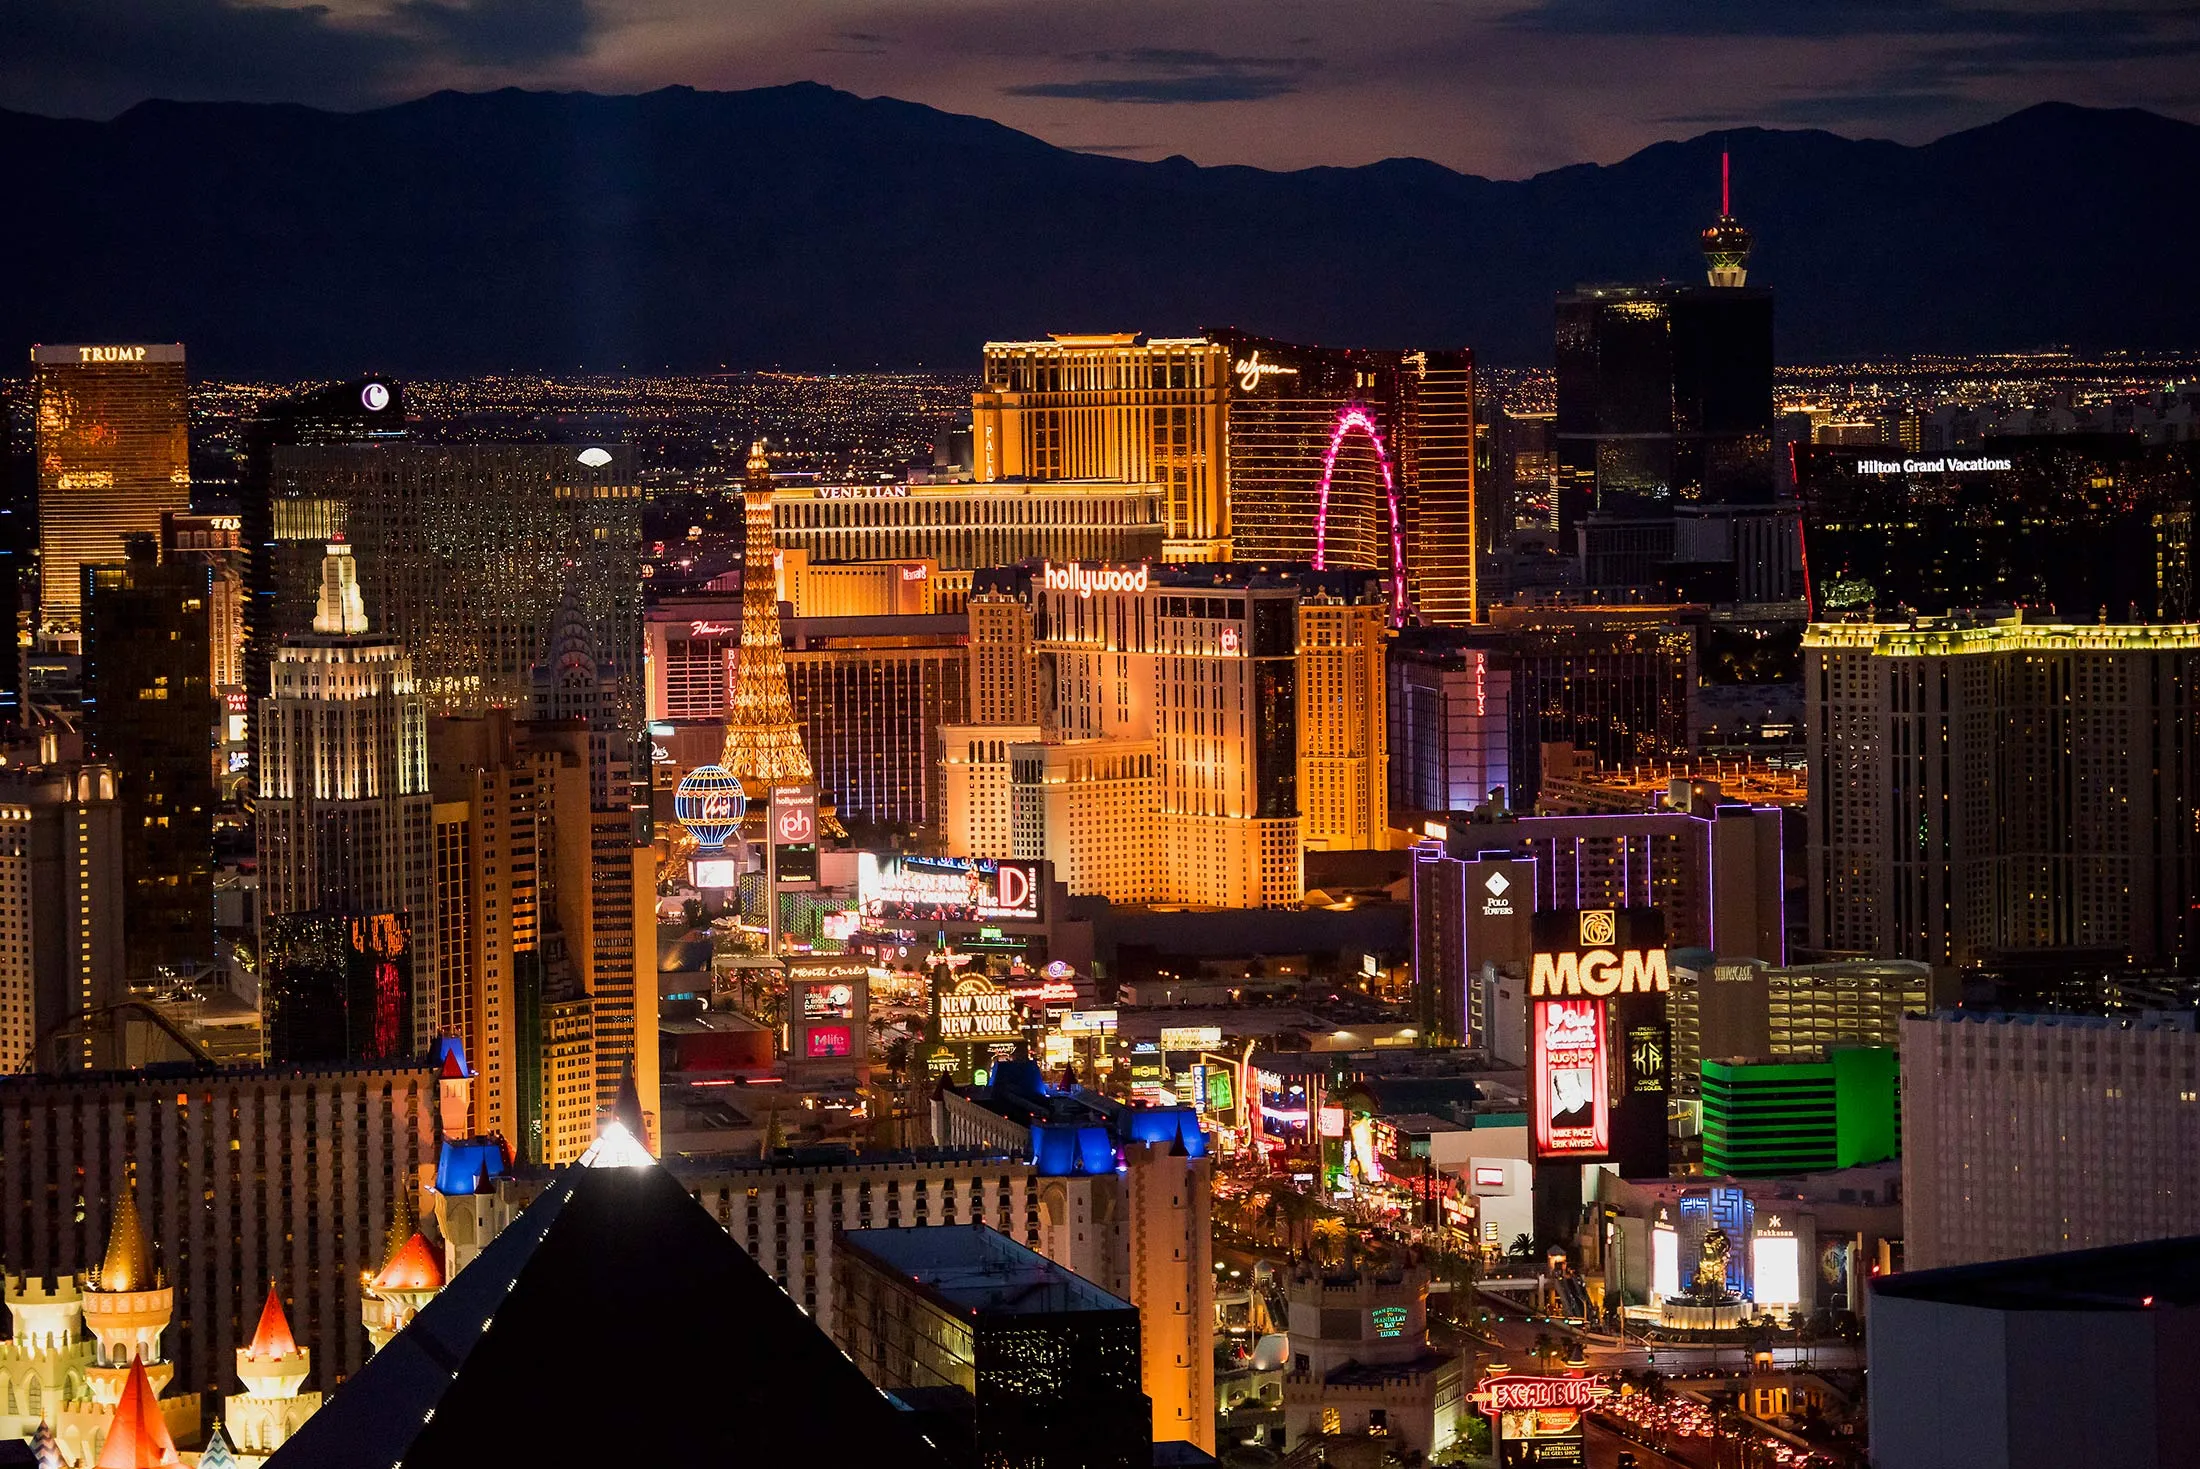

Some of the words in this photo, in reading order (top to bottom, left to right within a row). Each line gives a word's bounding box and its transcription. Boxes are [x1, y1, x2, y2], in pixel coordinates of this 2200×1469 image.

[79, 347, 146, 361] TRUMP
[1857, 459, 1900, 473] Hilton
[1903, 458, 1944, 472] Grand
[1947, 457, 2011, 472] Vacations
[818, 487, 907, 498] VENETIAN
[1044, 562, 1148, 598] hollywood
[690, 620, 734, 636] Flamingo
[776, 786, 800, 796] planet
[776, 795, 814, 805] hollywood
[783, 809, 810, 832] ph
[1000, 866, 1029, 908] D
[790, 967, 828, 978] Monte
[828, 965, 867, 977] Carlo
[1531, 949, 1670, 996] MGM
[940, 995, 972, 1013] NEW
[973, 994, 1012, 1012] YORK
[940, 1015, 972, 1033] NEW
[973, 1014, 1012, 1032] YORK
[1549, 1053, 1570, 1064] AUG
[1553, 1128, 1571, 1138] MIKE
[1552, 1140, 1568, 1149] ERIK
[1569, 1139, 1595, 1148] MYERS
[1757, 1229, 1794, 1237] Hakkasan
[1496, 1382, 1592, 1408] EXCALIBUR
